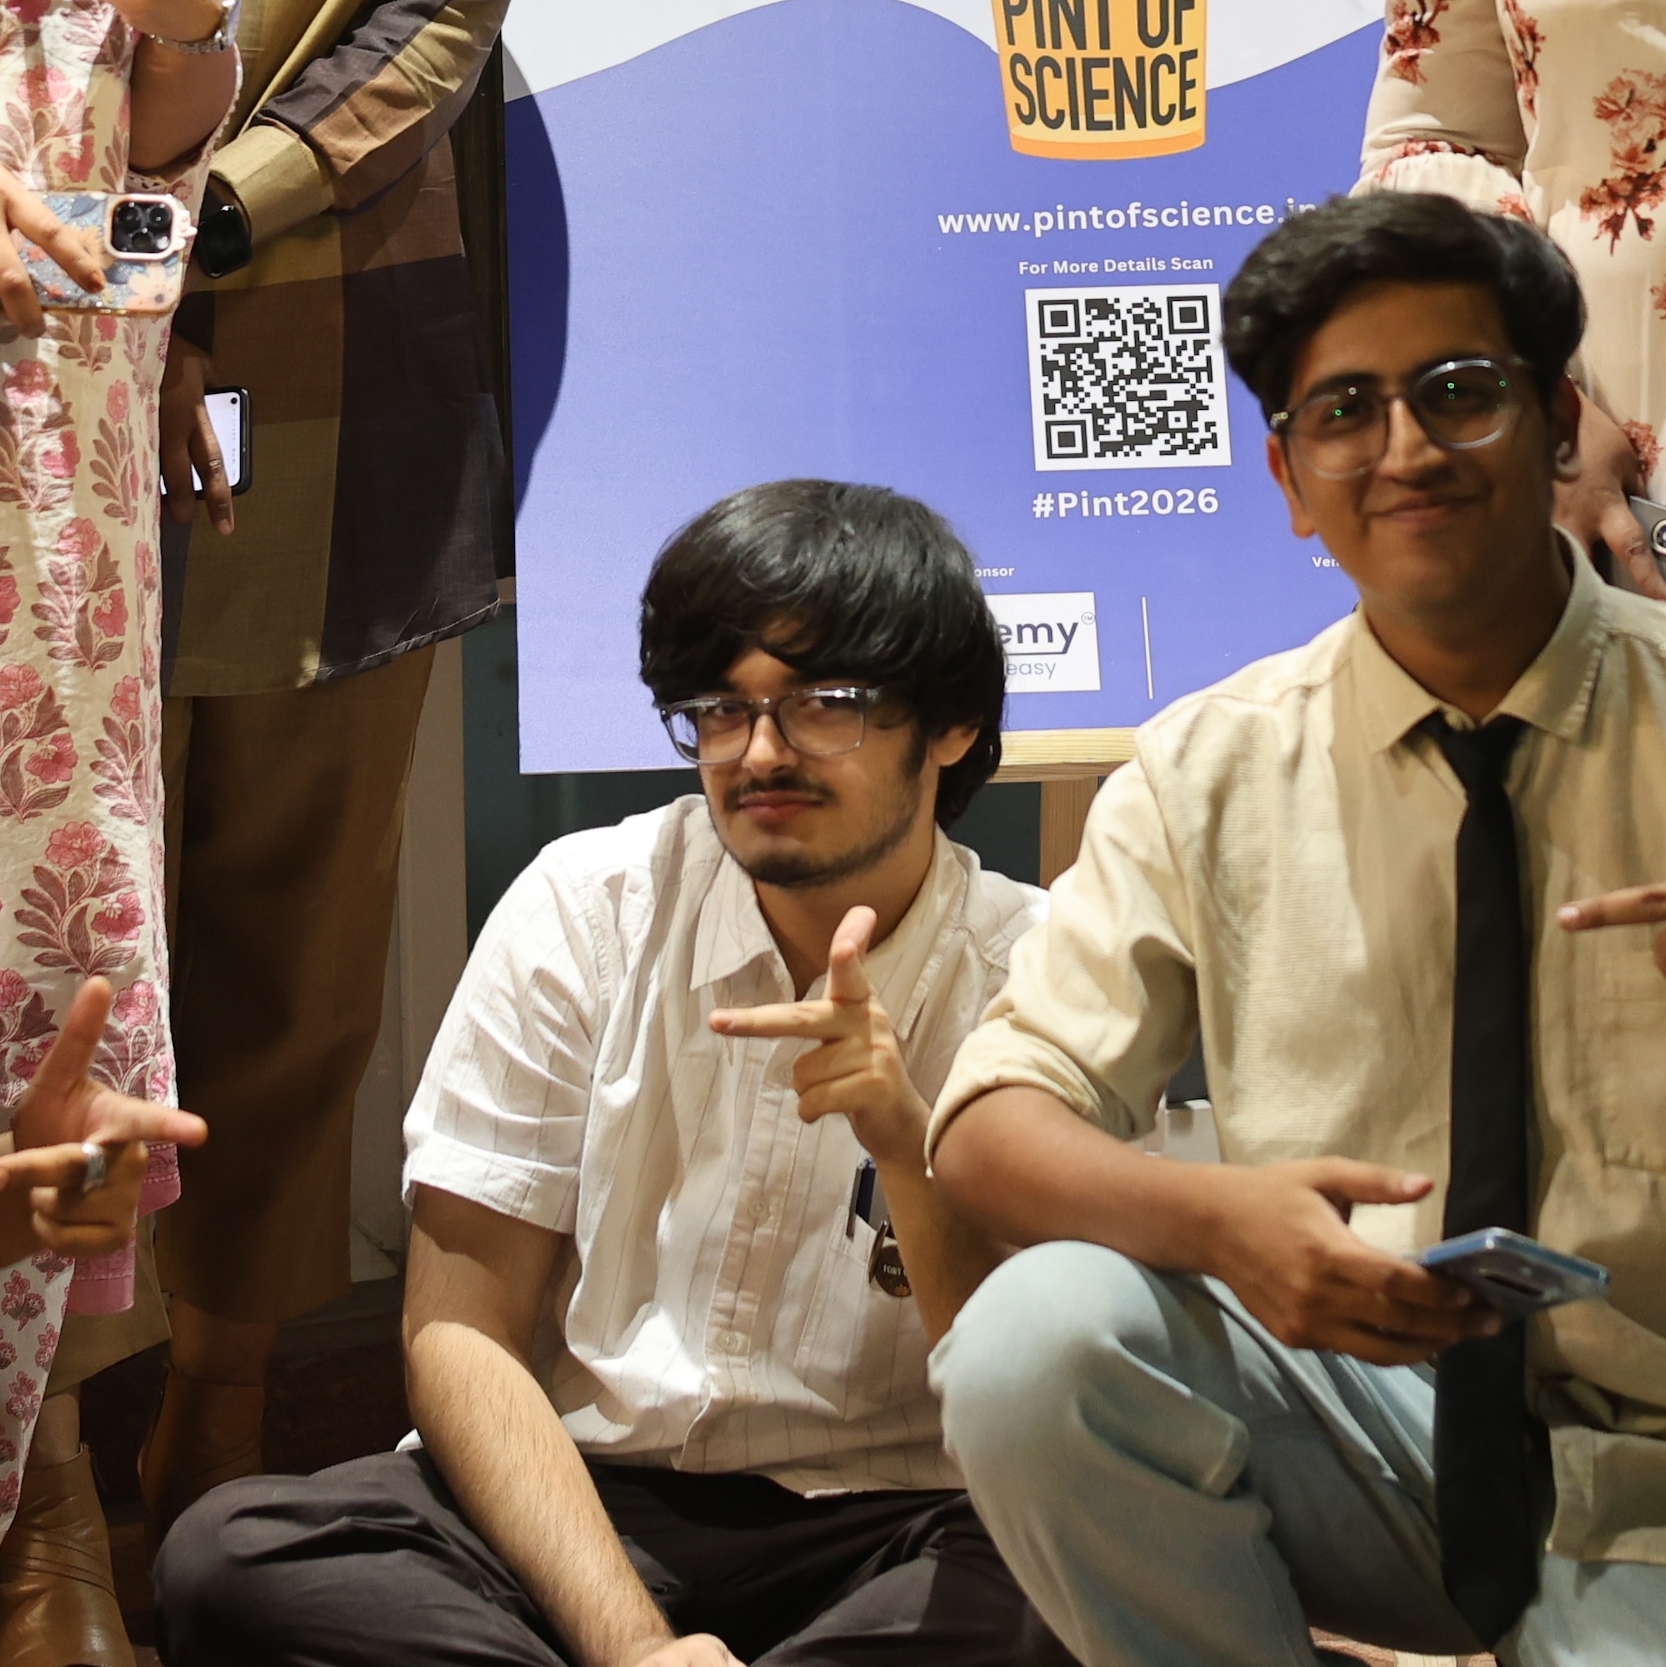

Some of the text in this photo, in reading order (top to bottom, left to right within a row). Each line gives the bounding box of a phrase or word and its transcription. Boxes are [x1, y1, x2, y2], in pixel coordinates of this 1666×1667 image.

[1010, 48, 1199, 132] SCIENCE
[1018, 256, 1214, 275] For More Details Scan
[1032, 488, 1220, 519] #Pint2026
[974, 566, 1015, 578] onsor
[997, 622, 1079, 655] emy
[1006, 662, 1057, 680] easy
